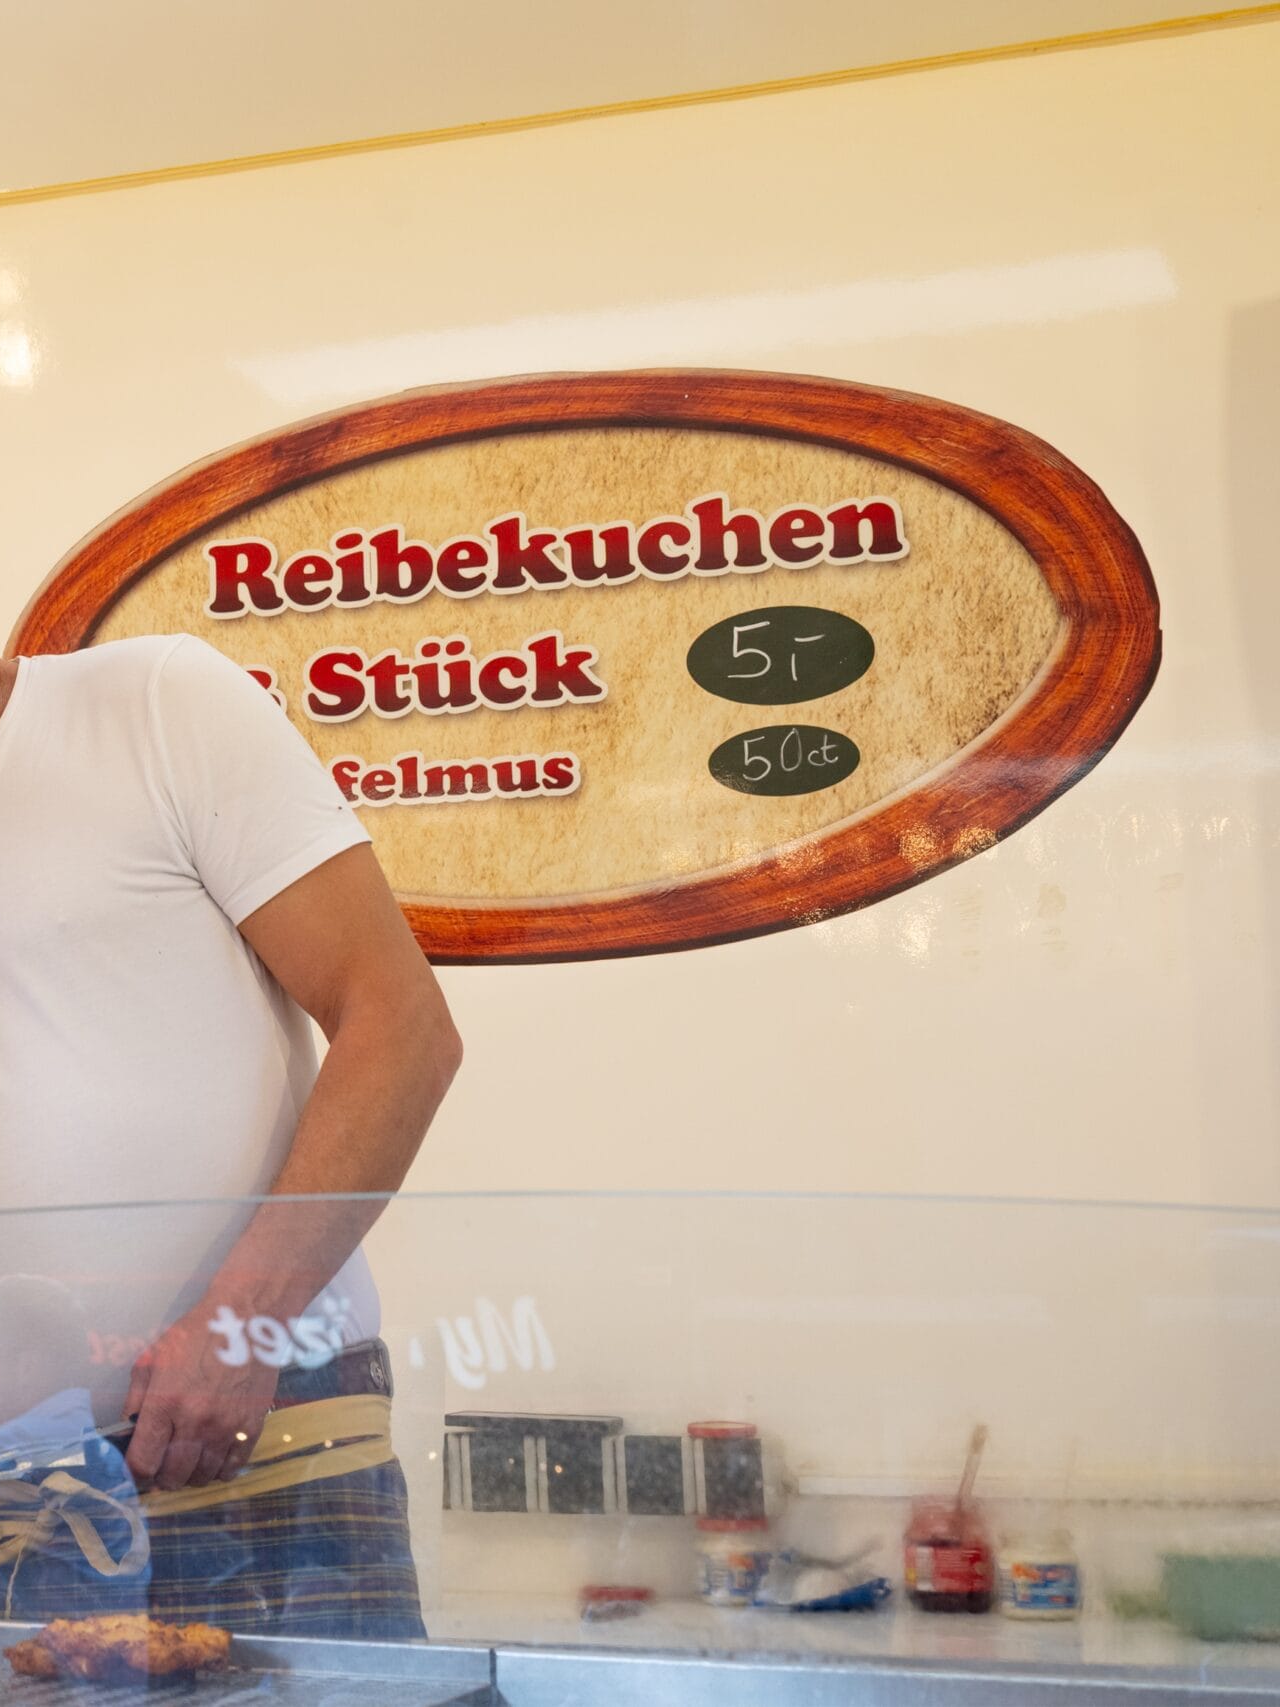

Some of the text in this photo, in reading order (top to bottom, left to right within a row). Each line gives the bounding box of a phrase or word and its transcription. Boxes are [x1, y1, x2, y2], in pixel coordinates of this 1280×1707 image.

[207, 496, 902, 612] Reibekuchen
[307, 635, 597, 717] Stück
[331, 755, 575, 804] felmus
